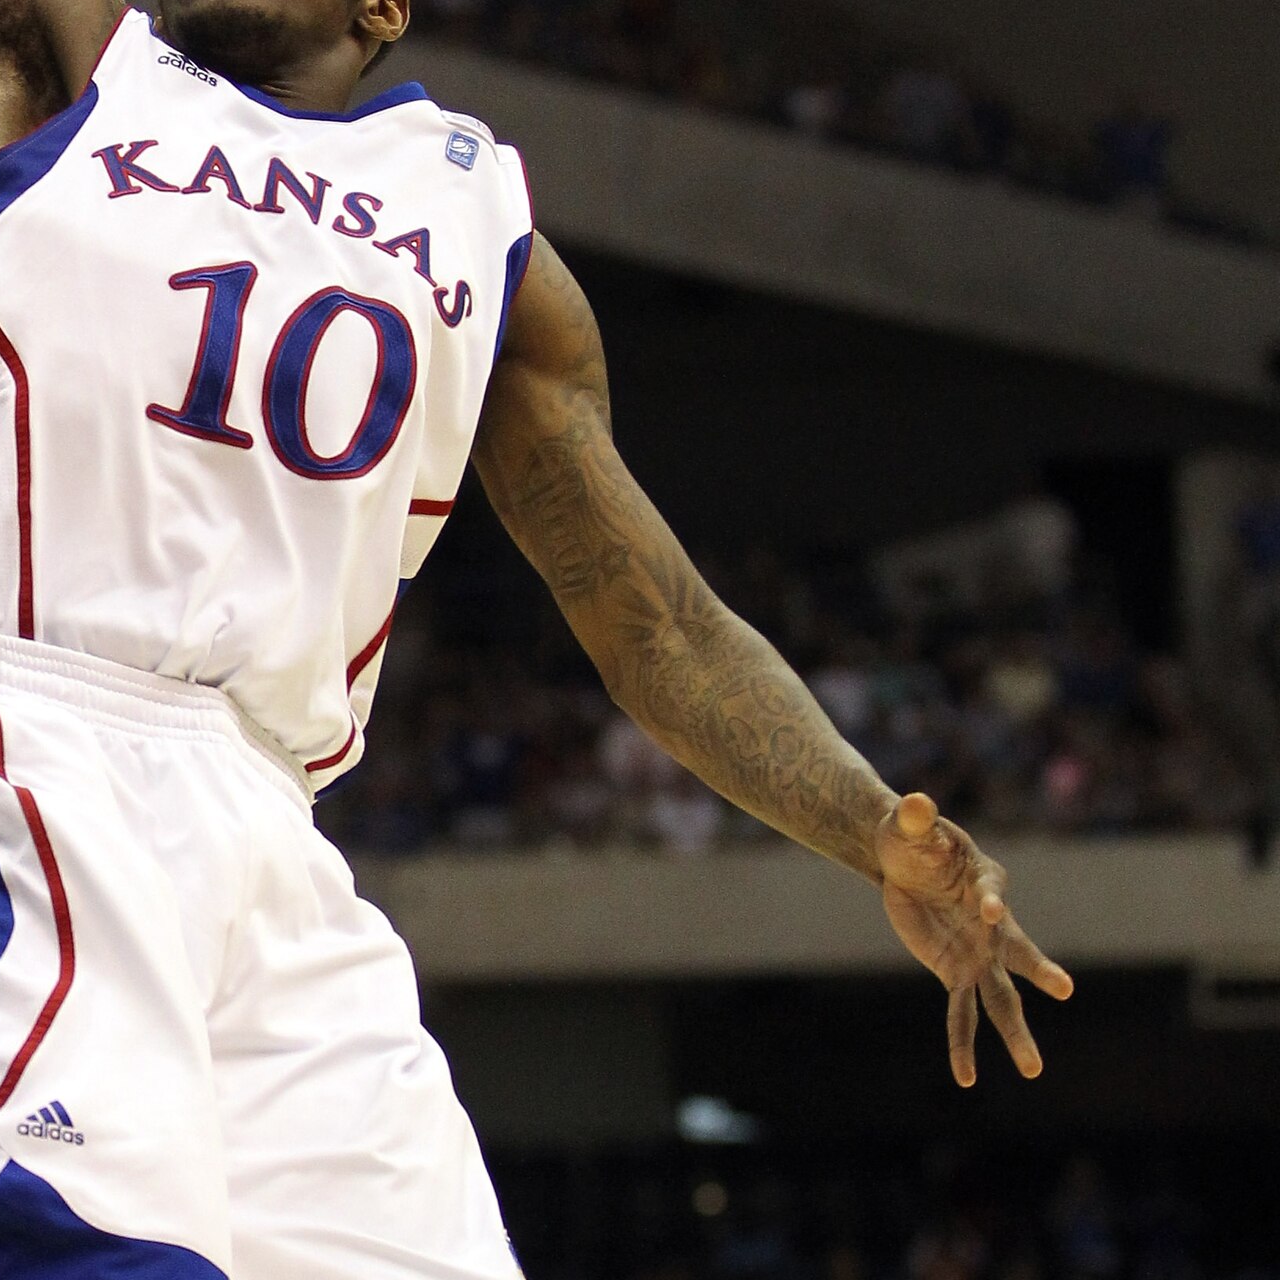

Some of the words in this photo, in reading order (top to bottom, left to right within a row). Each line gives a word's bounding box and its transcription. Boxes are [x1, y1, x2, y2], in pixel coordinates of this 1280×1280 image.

[157, 54, 218, 87] adidas
[91, 139, 473, 329] KANSAS
[145, 260, 418, 481] 10
[17, 1121, 85, 1146] adidas
